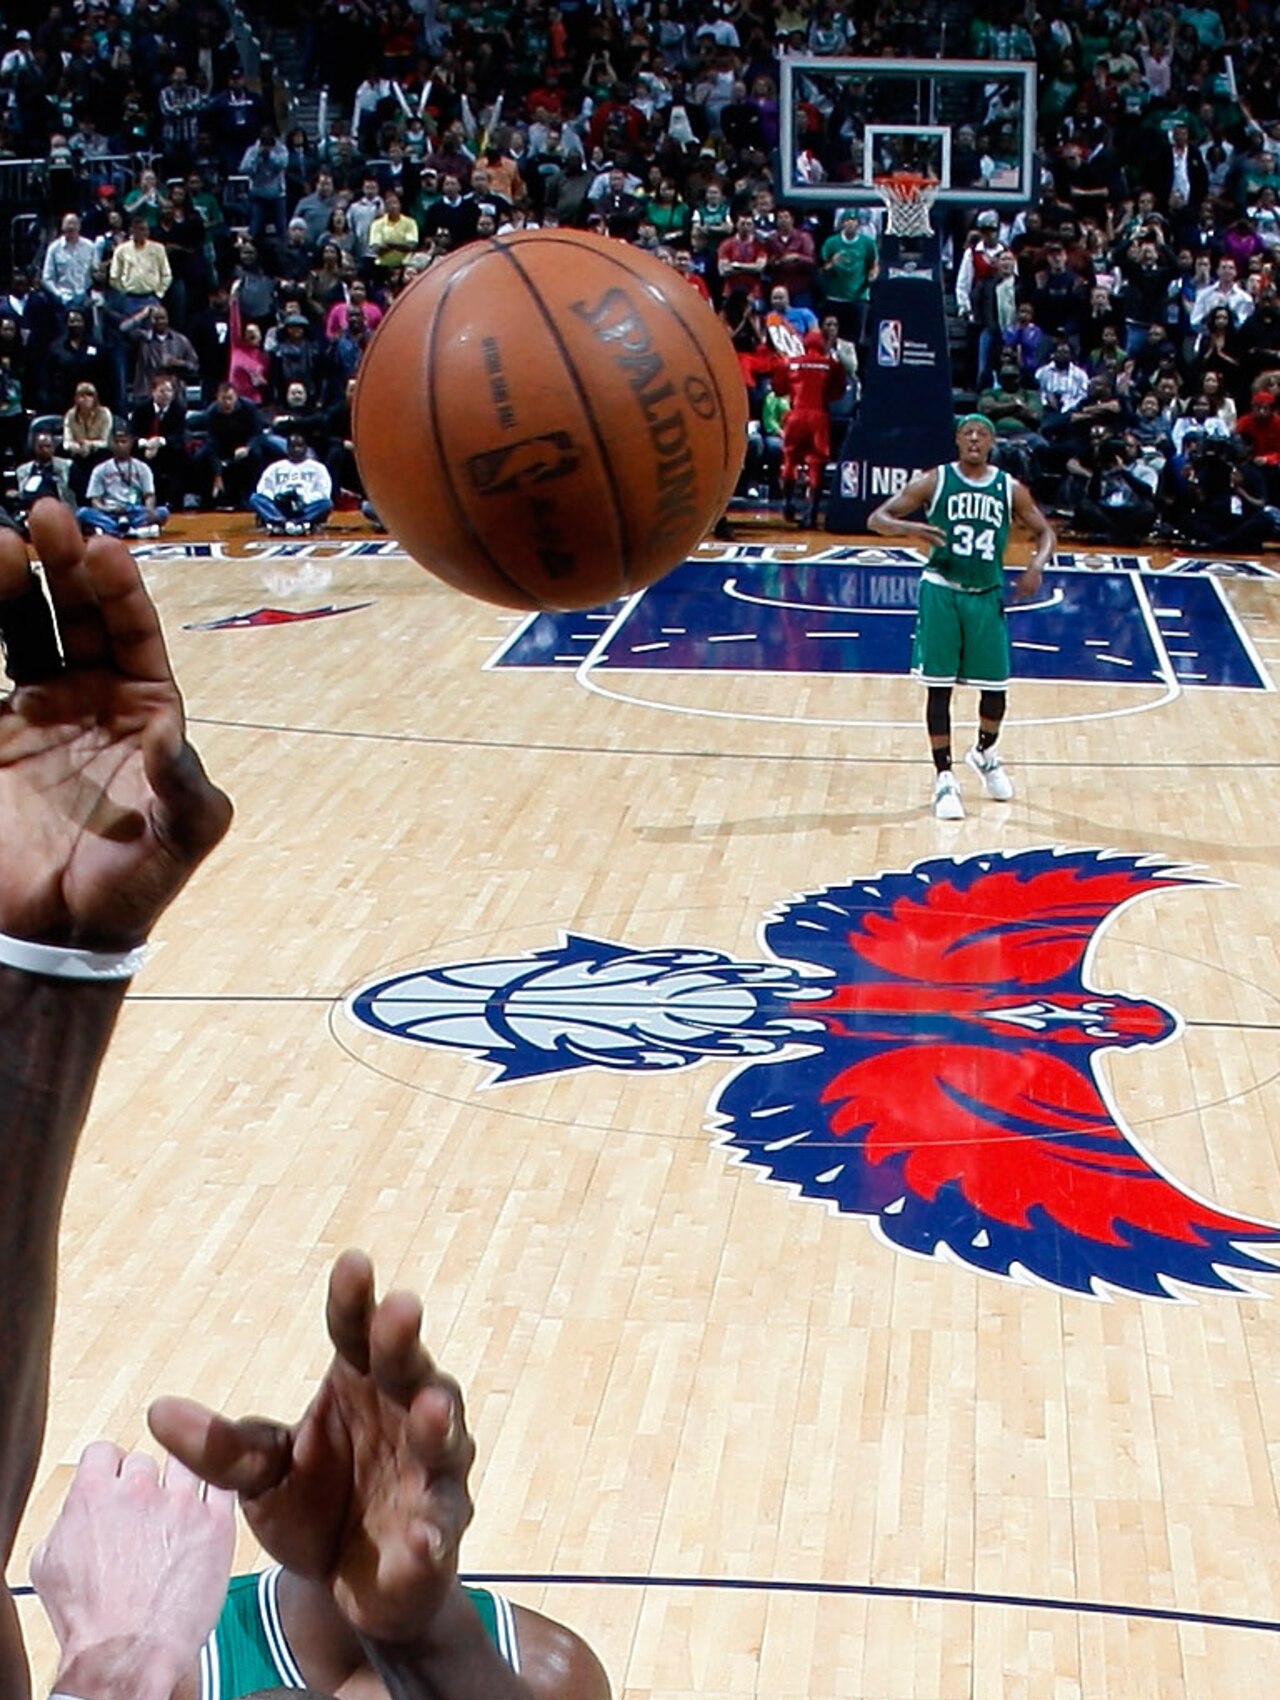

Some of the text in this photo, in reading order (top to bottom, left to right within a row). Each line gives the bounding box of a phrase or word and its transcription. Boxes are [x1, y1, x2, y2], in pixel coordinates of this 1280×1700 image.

[570, 286, 699, 541] SPALDING
[947, 492, 1004, 528] CELTICS
[951, 524, 996, 561] 34
